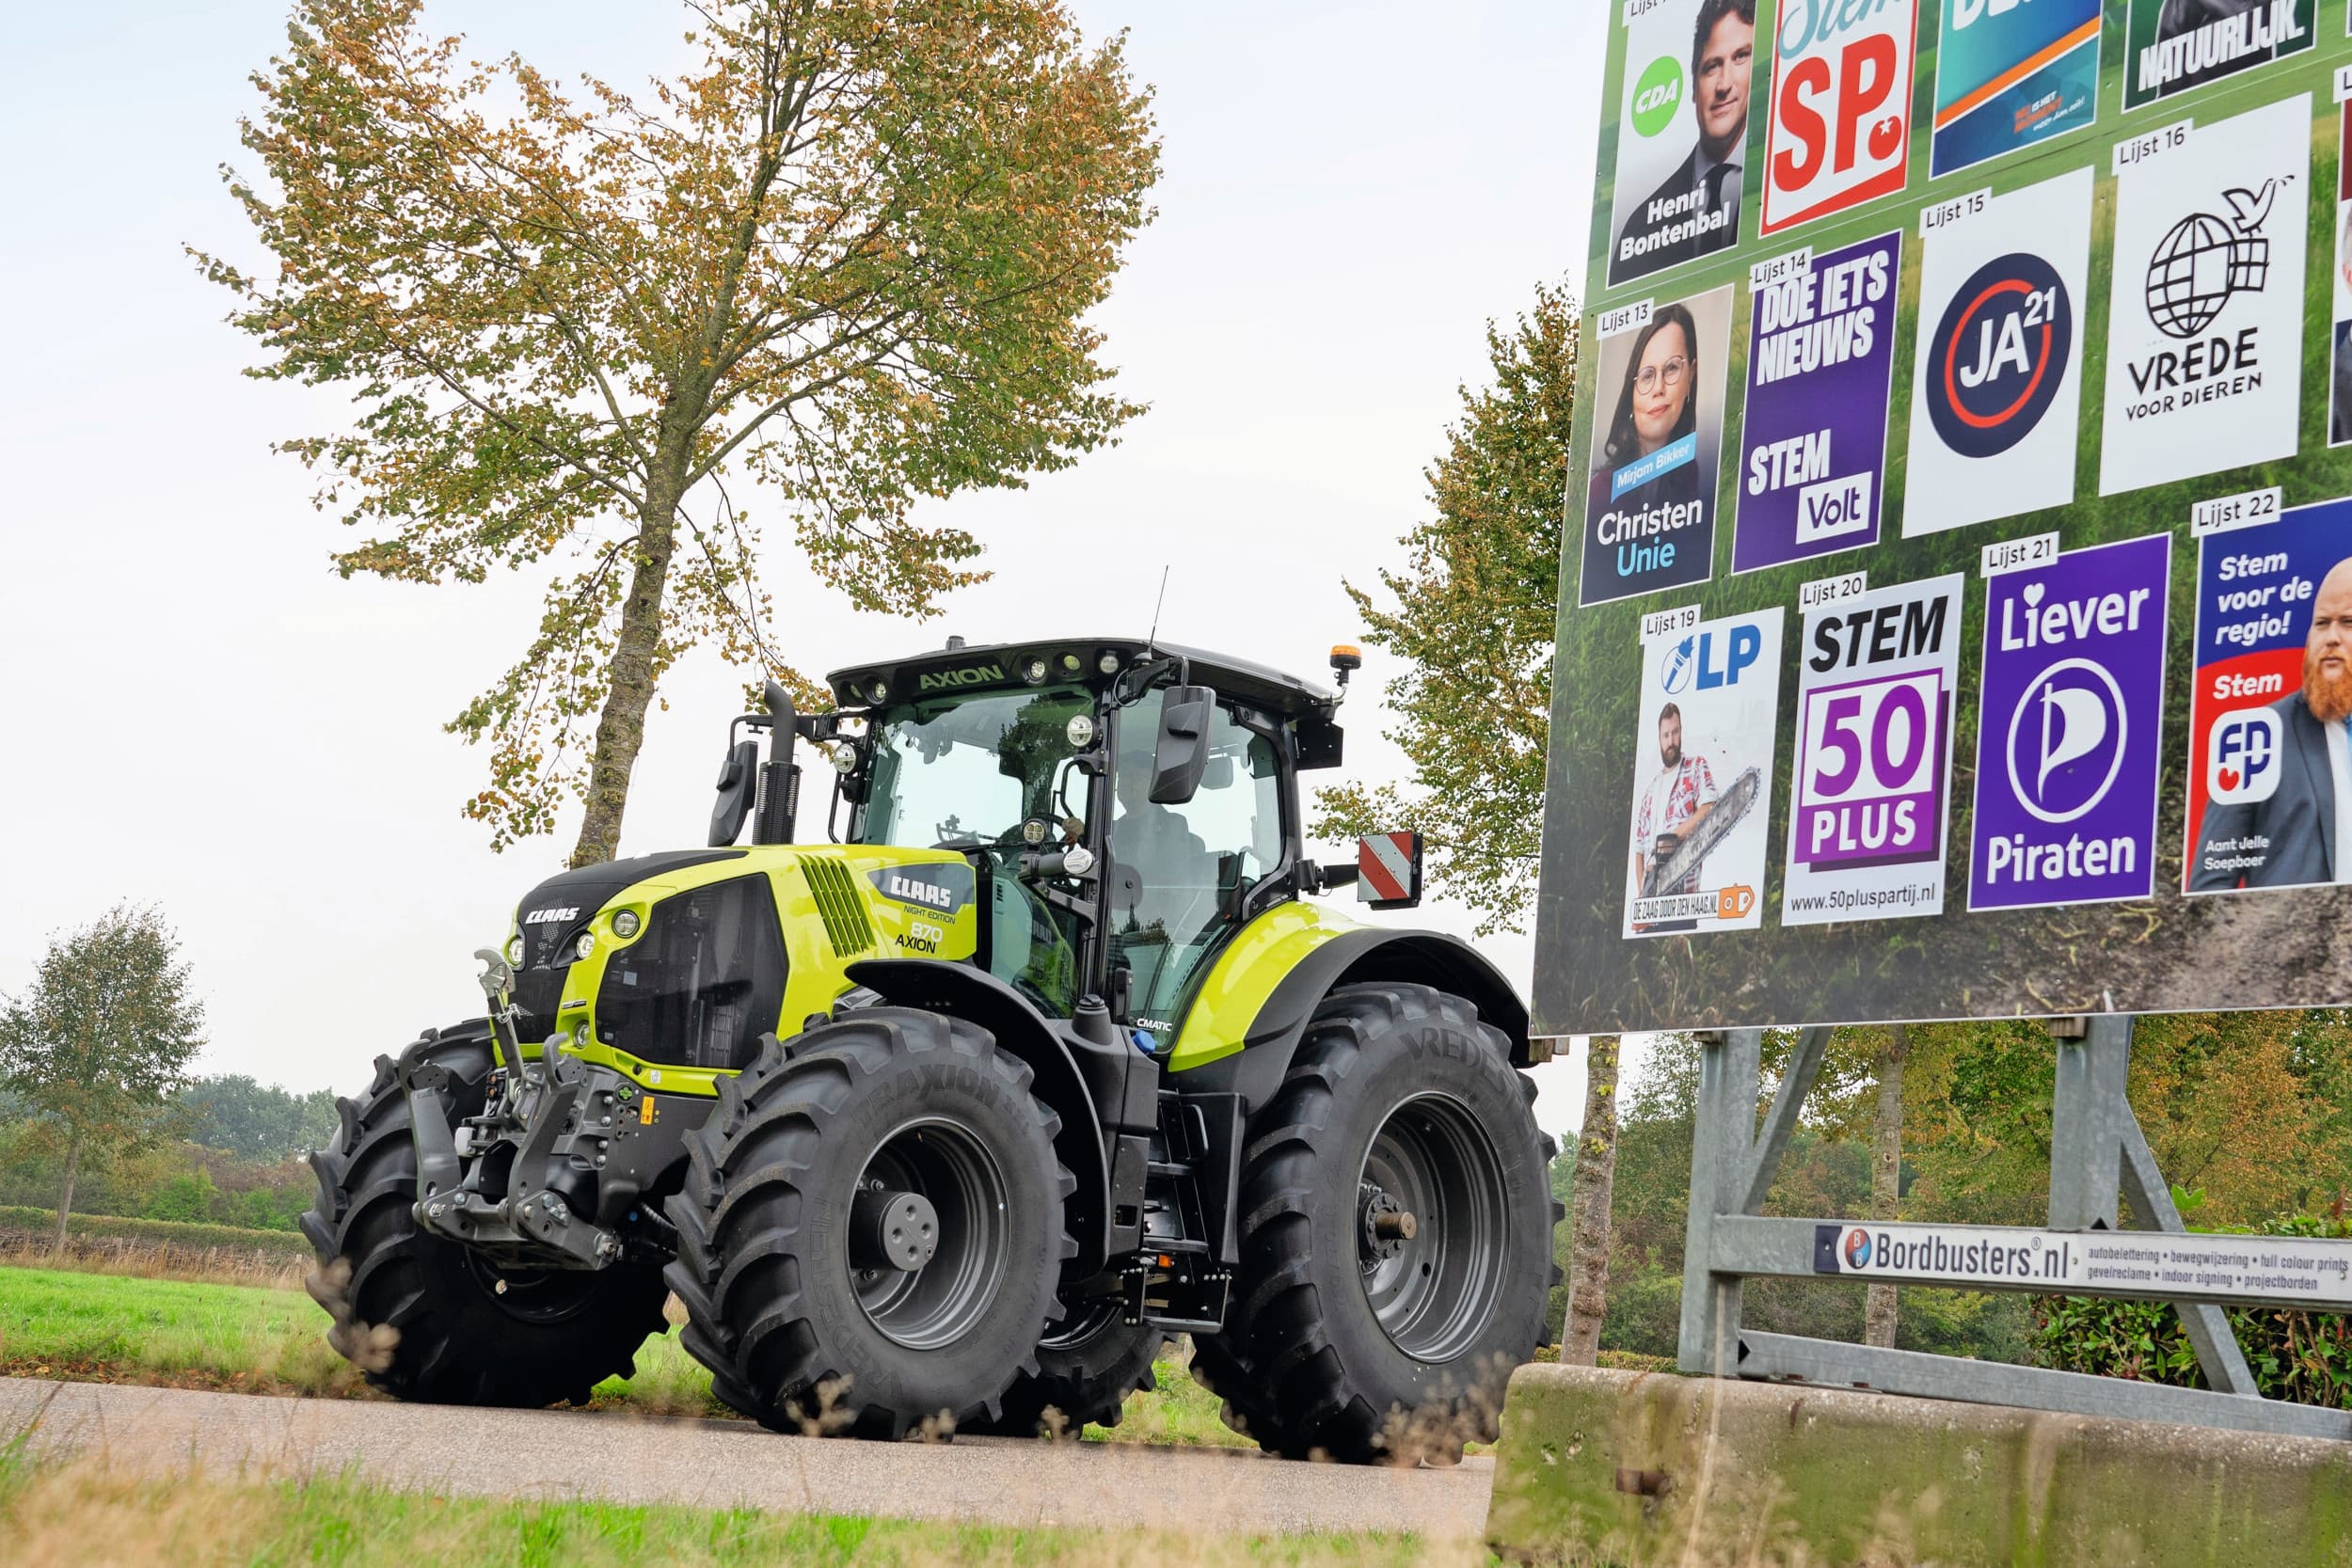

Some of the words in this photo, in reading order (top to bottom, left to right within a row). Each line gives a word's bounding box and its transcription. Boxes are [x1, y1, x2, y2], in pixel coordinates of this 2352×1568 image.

[2137, 0, 2305, 91] NATUURLIJK.
[1634, 78, 1678, 114] CDA
[2120, 136, 2158, 165] Lijst
[2166, 127, 2185, 149] 16
[1647, 181, 1706, 224] Henri
[1926, 203, 1961, 228] Lijst
[1968, 194, 1984, 214] 15
[1619, 202, 1730, 261] Bontenbal
[1755, 259, 1787, 283] Lijst
[1790, 253, 1806, 273] 14
[1760, 272, 1818, 334] DOE
[1820, 249, 1889, 315] IETS
[1601, 312, 1630, 332] Lijst
[1634, 304, 1648, 321] 13
[1756, 306, 1875, 387] NIEUWS
[2127, 325, 2259, 394] VREDE
[2126, 395, 2175, 420] VOOR
[2181, 372, 2263, 408] DIEREN
[1617, 459, 1653, 488] Mirjam
[1656, 441, 1690, 471] Bikker
[1748, 429, 1832, 497] STEM
[1597, 499, 1703, 546] Christen
[1806, 485, 1861, 529] Volt
[2199, 503, 2241, 528] Lijst
[2249, 494, 2274, 516] 22
[1616, 536, 1676, 577] Unie
[1988, 543, 2026, 569] Lijst
[2033, 537, 2051, 558] 21
[2218, 551, 2288, 581] Stem
[1804, 582, 1836, 607] Lijst
[1842, 577, 1862, 596] 20
[2217, 587, 2275, 612] voor
[2280, 577, 2312, 602] de
[1646, 614, 1677, 636] Lijst
[1680, 610, 1694, 628] 19
[1808, 594, 1948, 673] STEM
[2001, 582, 2150, 652] Liever
[2215, 611, 2291, 646] regio!
[1696, 624, 1761, 690] LP
[919, 664, 1005, 689] AXION
[2213, 673, 2282, 700] Stem
[1813, 684, 1927, 797] 50
[1811, 800, 1916, 854] PLUS
[2205, 838, 2237, 852] Aant
[2239, 835, 2269, 849] Jelle
[1986, 832, 2136, 884] Piraten
[2204, 854, 2265, 872] Soepboer
[890, 875, 951, 908] CLAAS
[1633, 903, 1642, 920] DE
[1643, 901, 1657, 919] ZAAG
[1660, 899, 1676, 918] DOOR
[1677, 897, 1690, 916] DEN
[1691, 895, 1717, 915] HAAG.NL
[1791, 882, 1935, 911] www.50pluspartij.nl
[525, 908, 580, 924] CLAAS
[903, 905, 926, 918] NIGHT
[928, 911, 956, 926] EDITION
[911, 922, 943, 943] 870
[895, 934, 936, 954] AXION
[1136, 1019, 1172, 1032] CMATIC
[2088, 1247, 2159, 1264] autobelettering
[2170, 1249, 2249, 1269] bewegwijzering
[2261, 1254, 2278, 1268] full
[2280, 1256, 2314, 1270] colour
[2317, 1257, 2349, 1273] prints
[2088, 1266, 2151, 1280] gevelreclame
[2162, 1268, 2193, 1282] indoor
[2196, 1270, 2233, 1288] signing
[2244, 1273, 2318, 1290] projectborden
